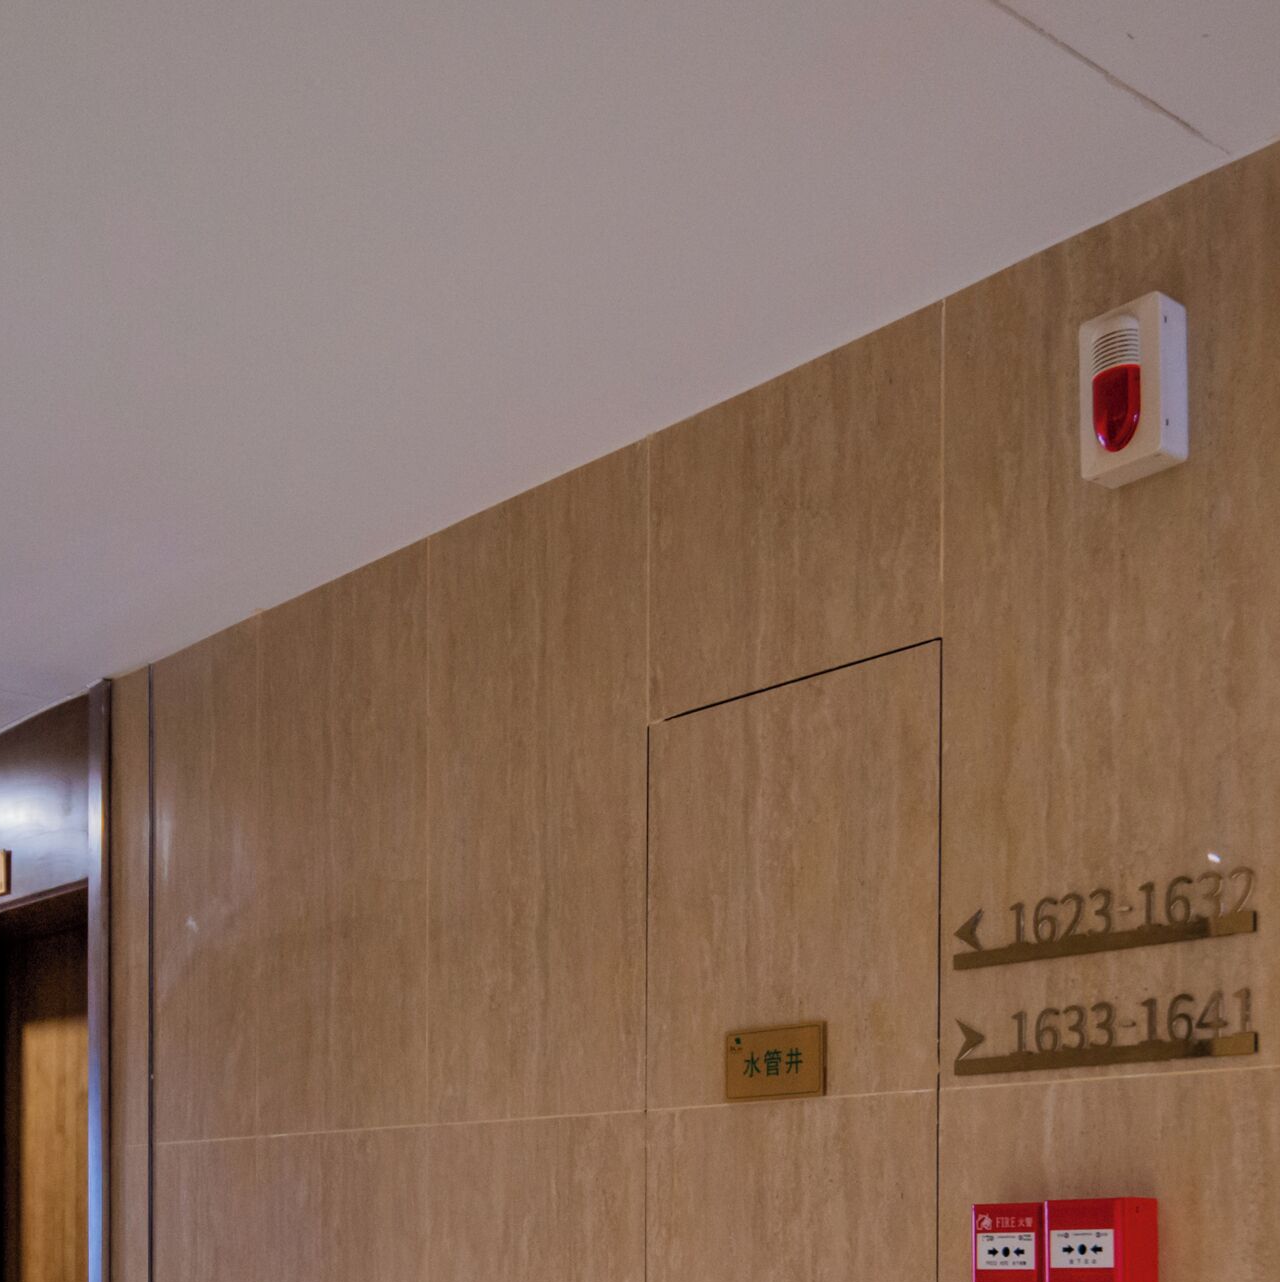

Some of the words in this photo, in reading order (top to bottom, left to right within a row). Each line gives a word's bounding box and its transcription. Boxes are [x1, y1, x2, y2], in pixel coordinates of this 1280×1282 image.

[1009, 866, 1255, 942] 1623-1632
[1011, 987, 1253, 1055] 1633-1641
[743, 1047, 803, 1078] 水管井
[996, 1217, 1016, 1228] FIRE
